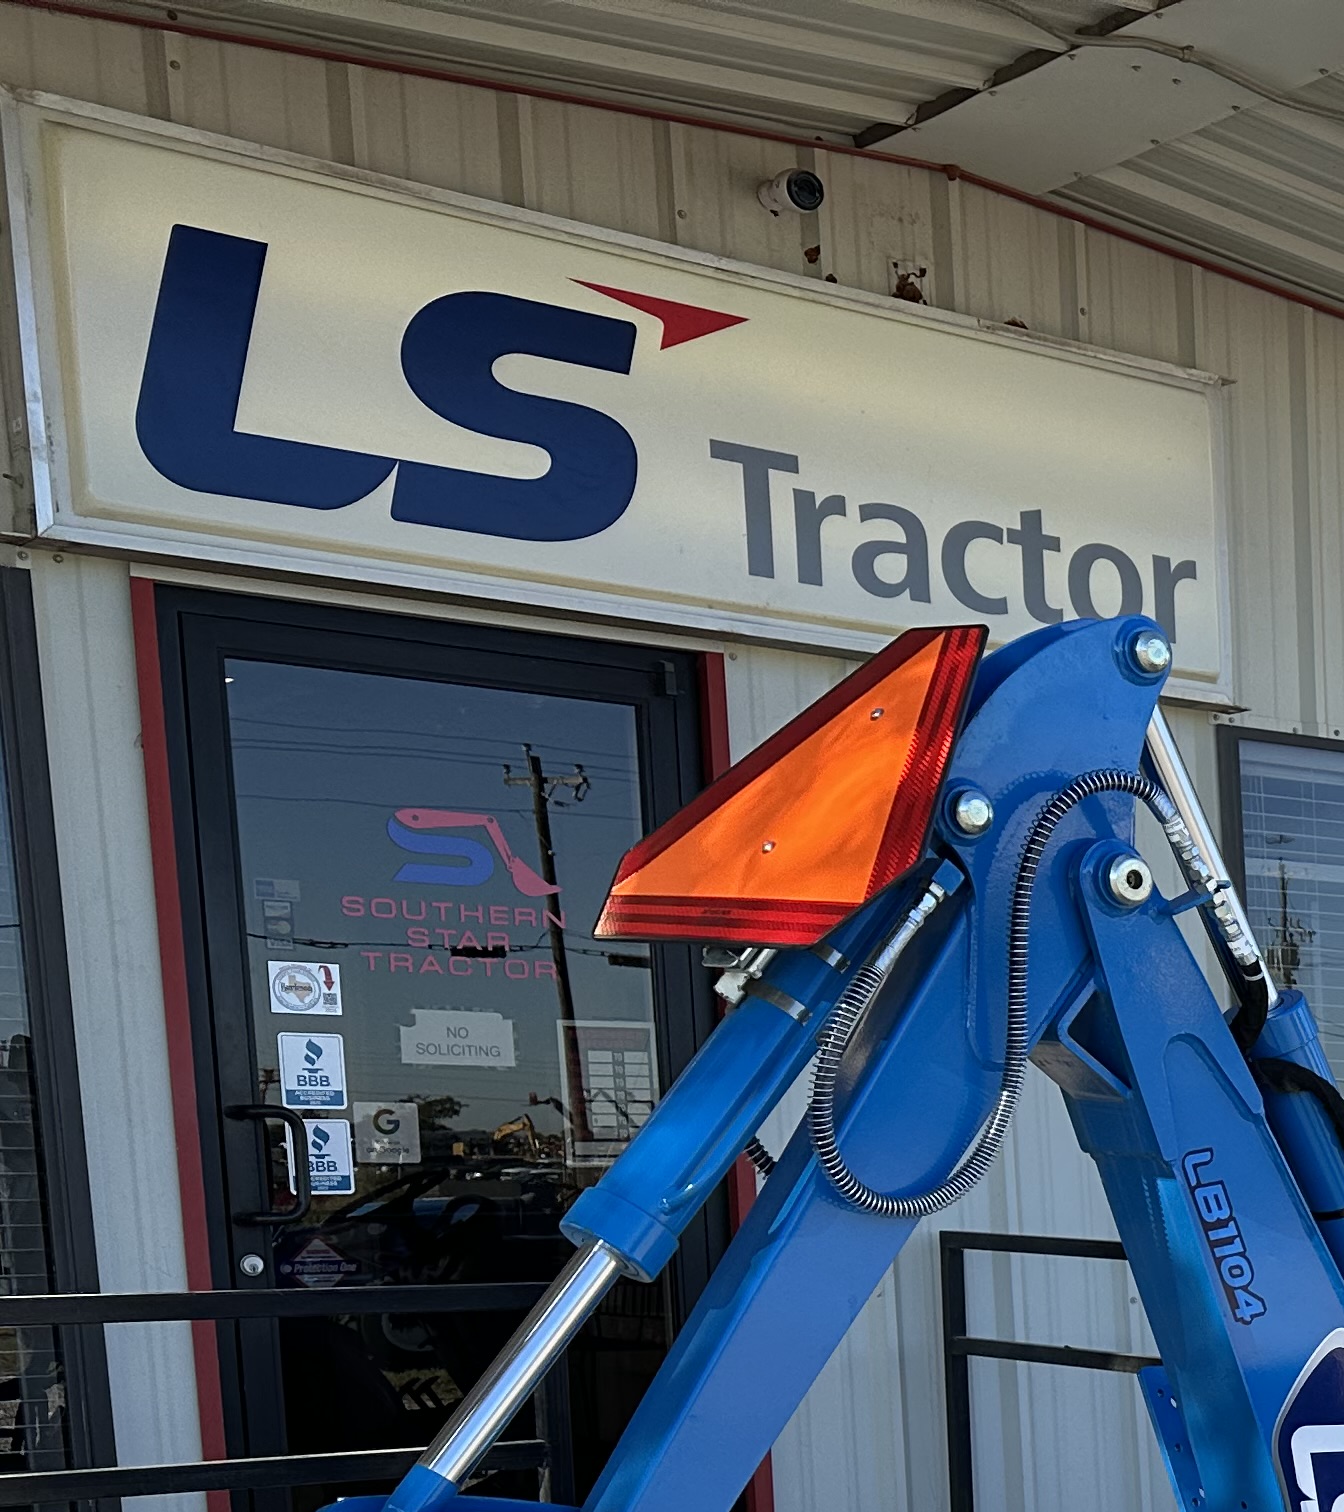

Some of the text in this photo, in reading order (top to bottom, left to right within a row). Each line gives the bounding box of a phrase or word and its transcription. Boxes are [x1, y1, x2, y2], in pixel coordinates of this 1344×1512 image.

[135, 223, 1197, 644] LS Tractor
[341, 896, 566, 929] SOUTHERN
[407, 927, 510, 952] STAR
[361, 951, 558, 980] TRACTOR
[446, 1027, 469, 1039] NO
[416, 1043, 501, 1058] SOLICITING
[297, 1075, 331, 1087] BBB
[1182, 1147, 1267, 1326] LB1104
